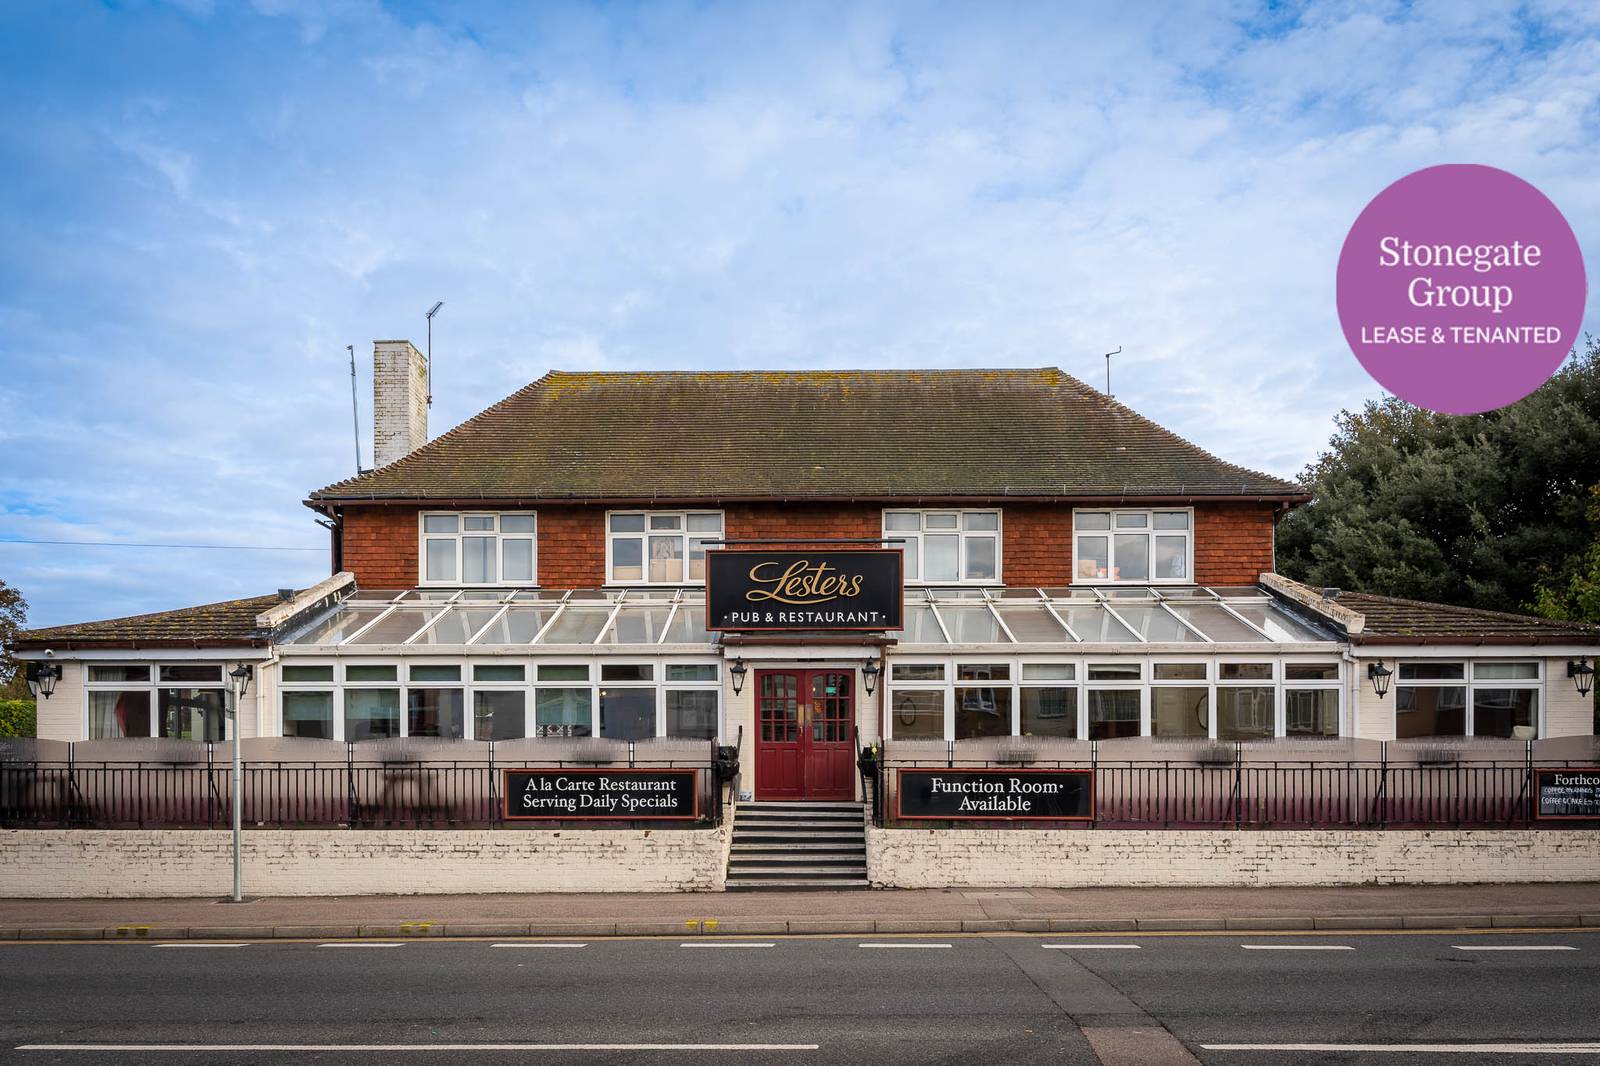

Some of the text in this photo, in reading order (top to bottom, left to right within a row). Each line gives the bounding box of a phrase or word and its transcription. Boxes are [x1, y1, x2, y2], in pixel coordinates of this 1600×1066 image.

[745, 559, 864, 605] Lesters
[731, 611, 879, 623] PUB & RESTAURANT
[525, 777, 677, 791] A la Carte Restaurant
[929, 777, 1005, 793] Function
[1554, 774, 1600, 785] Forthco
[523, 794, 678, 811] Serving Daily Specials
[958, 795, 1032, 811] Available
